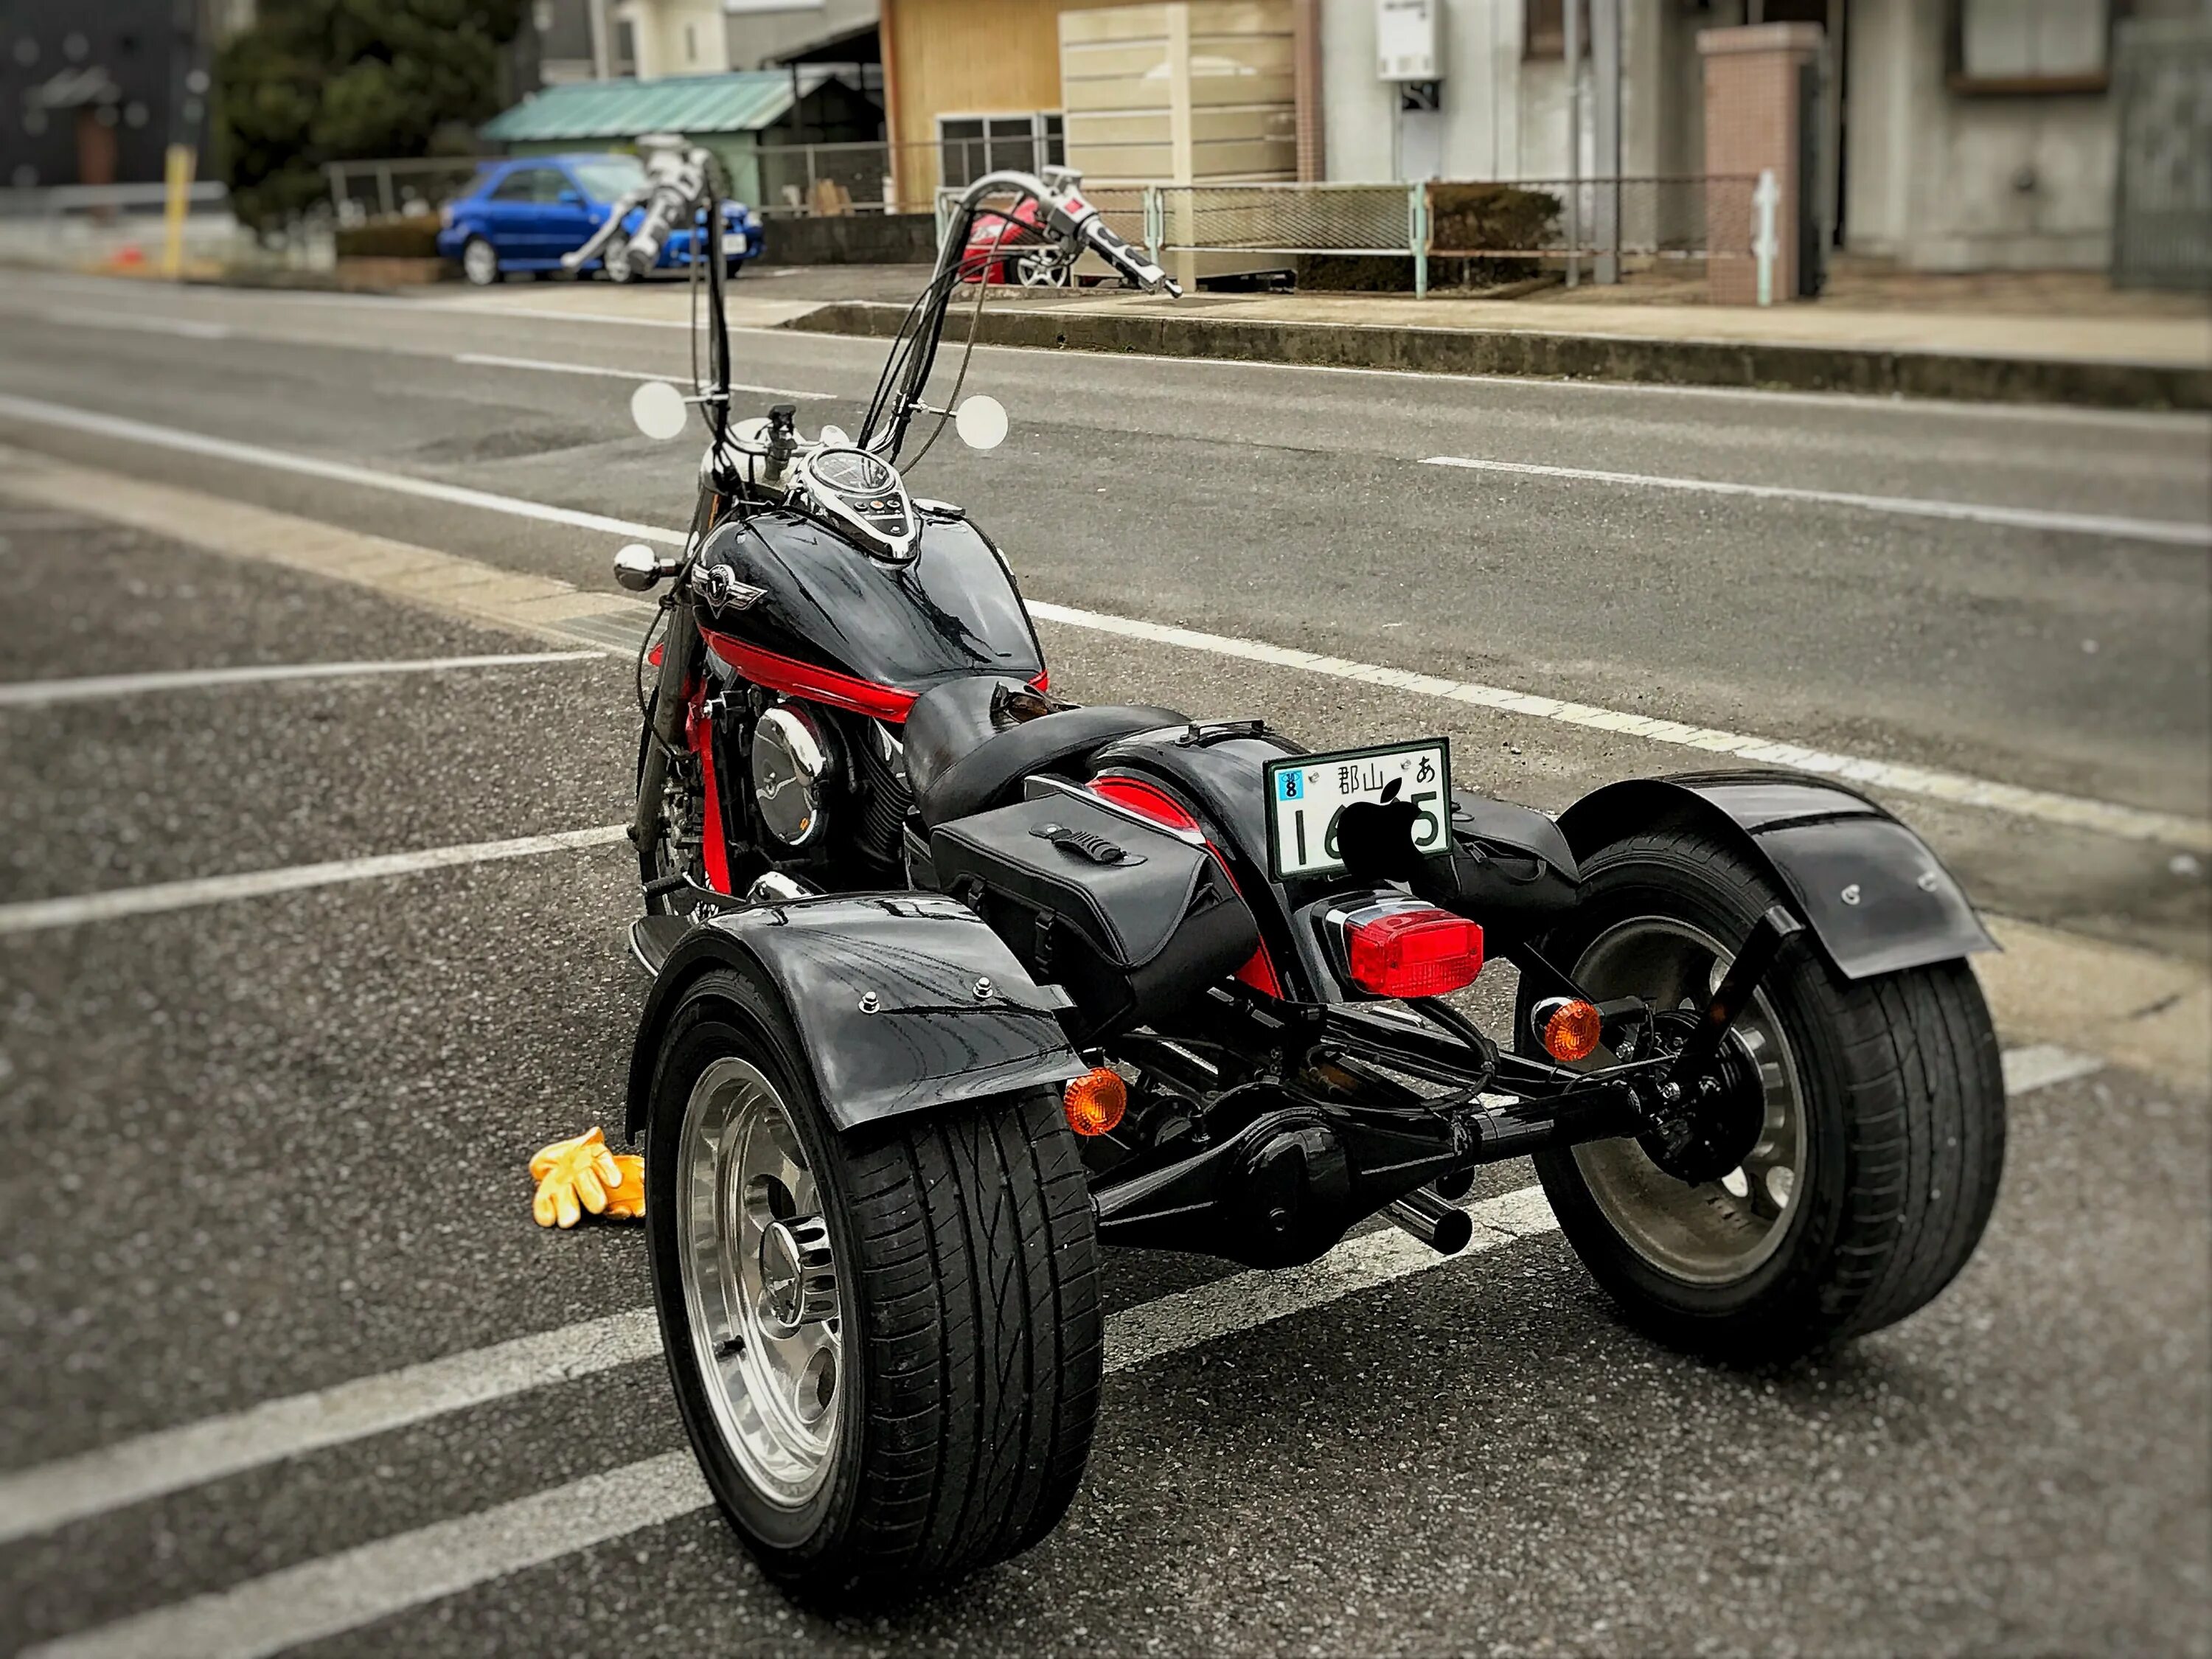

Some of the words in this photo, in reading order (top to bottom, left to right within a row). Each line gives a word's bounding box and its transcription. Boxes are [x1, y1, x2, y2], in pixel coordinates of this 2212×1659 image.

[1286, 782, 1297, 797] 8
[1338, 762, 1384, 794] 郡山
[1416, 756, 1436, 783] あ
[1295, 790, 1439, 866] 165
